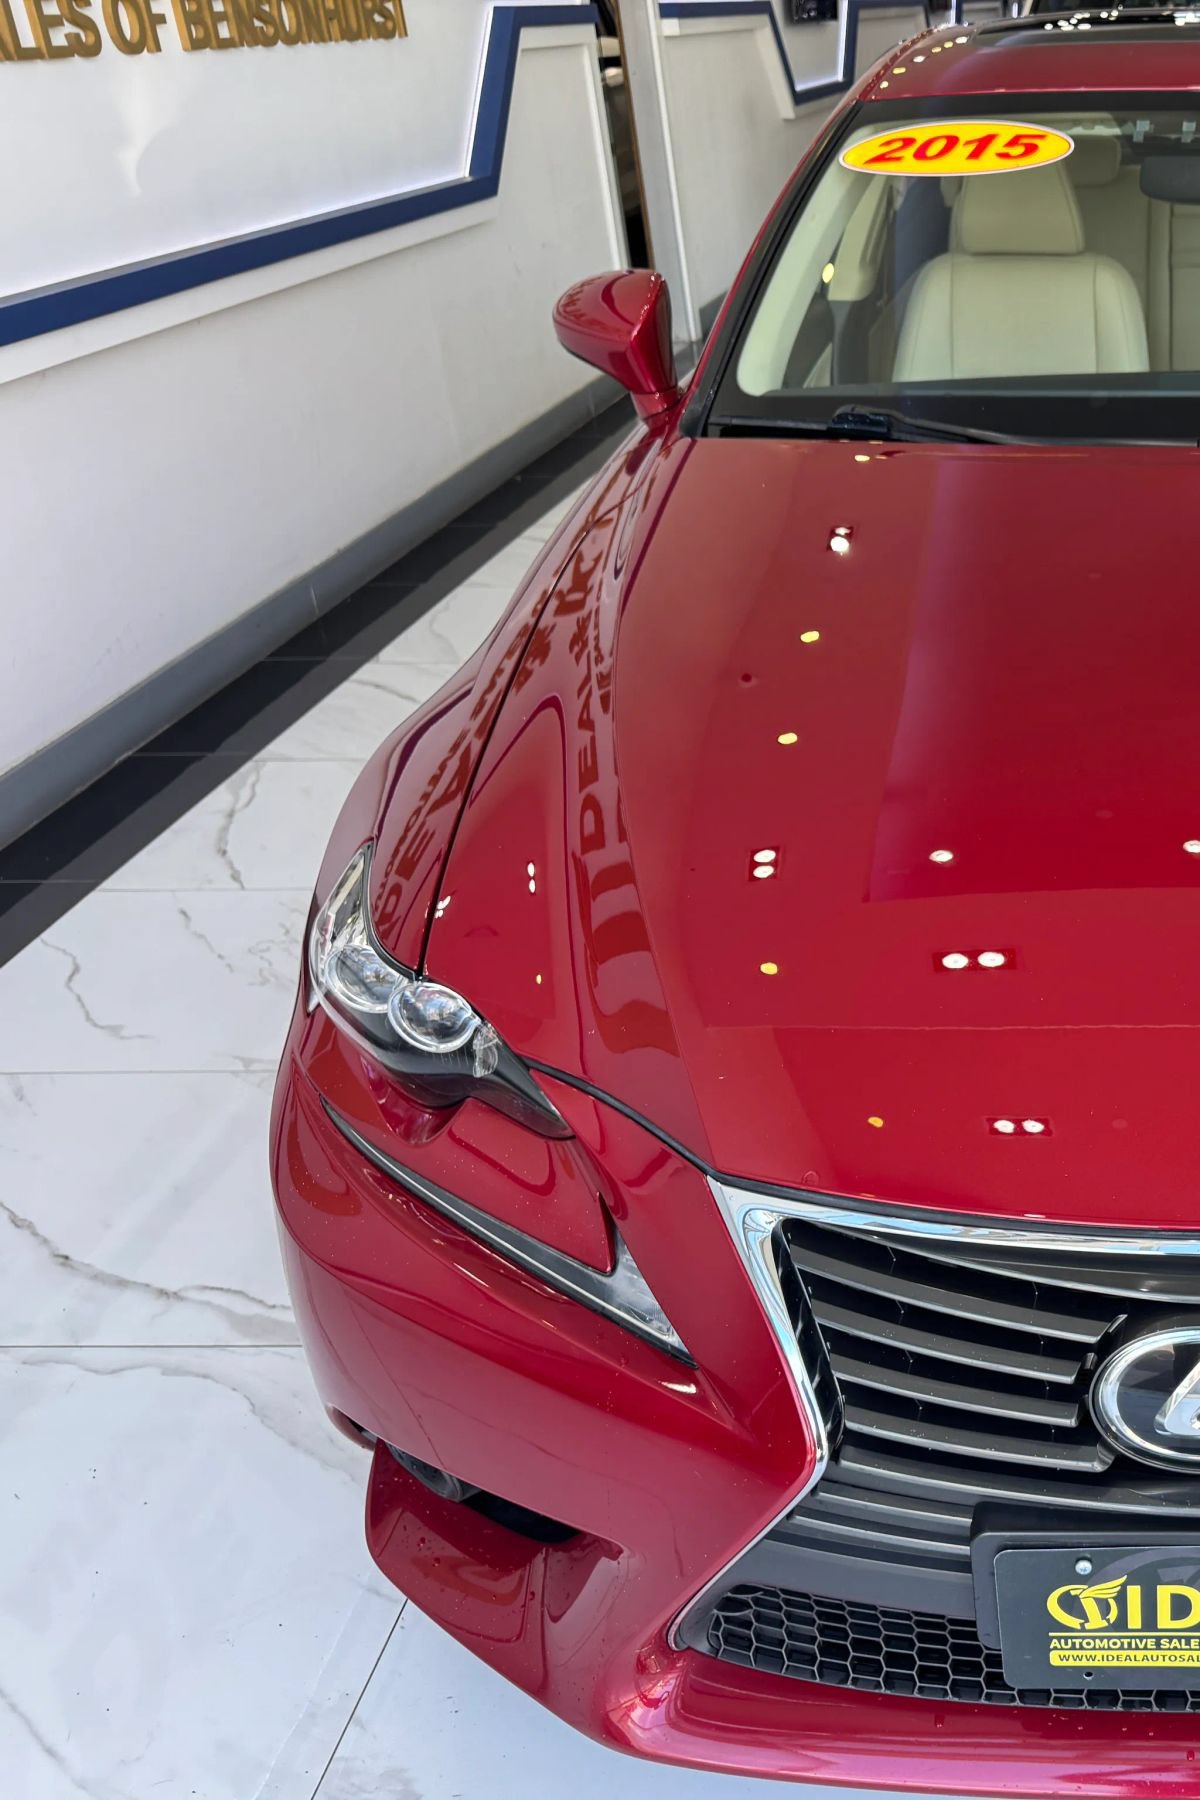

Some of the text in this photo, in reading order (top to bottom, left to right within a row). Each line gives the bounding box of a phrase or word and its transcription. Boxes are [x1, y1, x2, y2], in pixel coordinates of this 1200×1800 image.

[101, 0, 167, 54] OF
[864, 133, 1048, 165] 2015
[1050, 1638, 1156, 1650] AUTOMOTIVE
